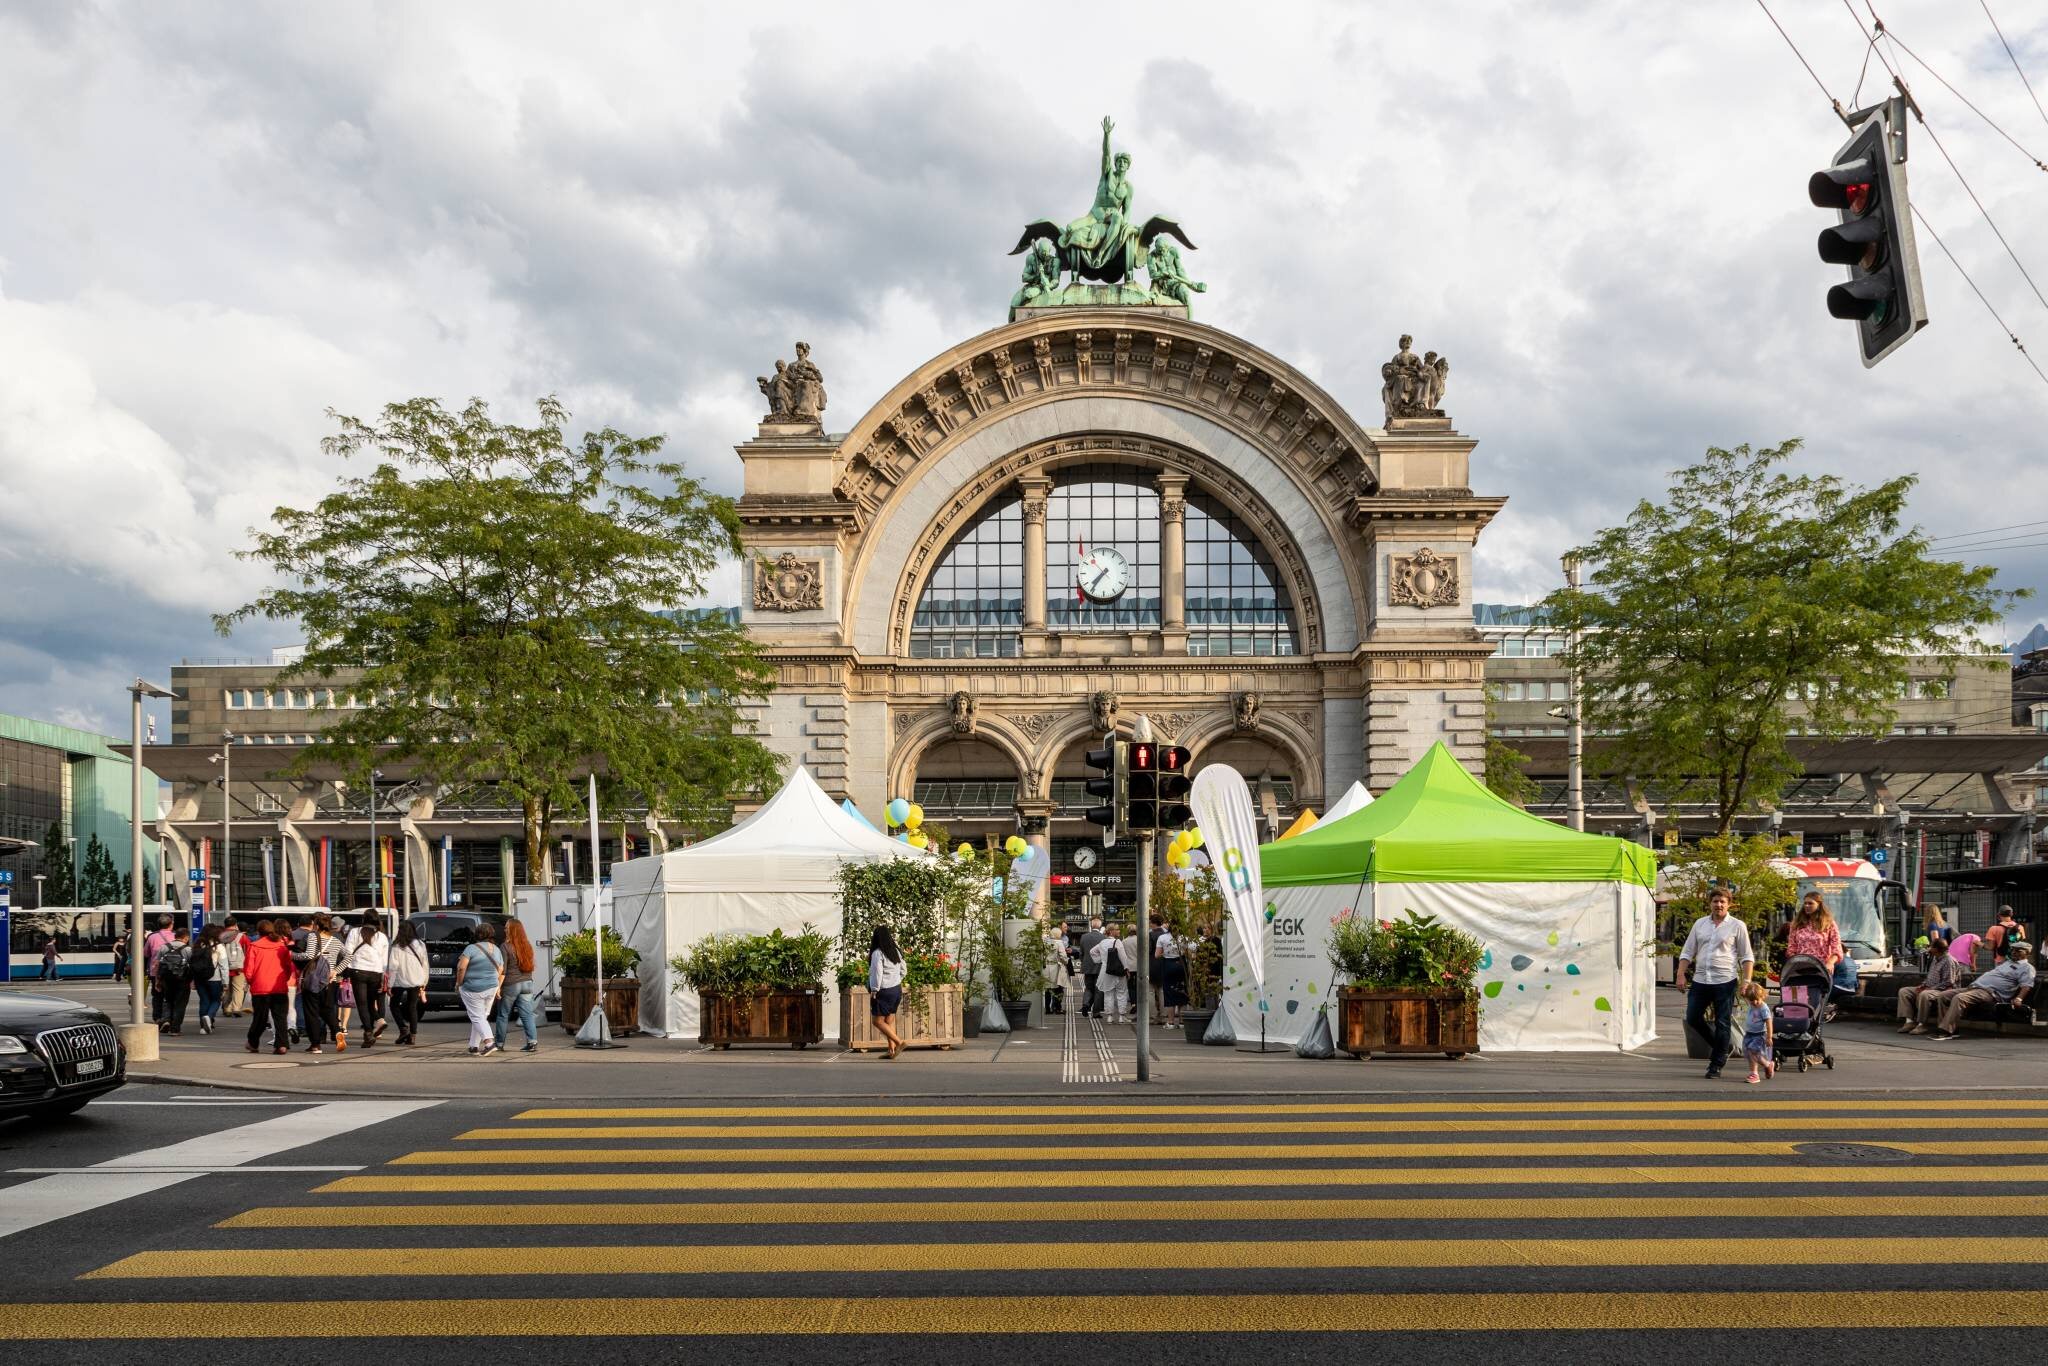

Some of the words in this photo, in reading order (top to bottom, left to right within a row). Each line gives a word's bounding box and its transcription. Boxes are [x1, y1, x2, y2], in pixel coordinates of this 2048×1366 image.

[1874, 851, 1884, 861] G
[5, 872, 12, 881] S
[191, 870, 198, 879] R
[1273, 918, 1305, 936] EGK
